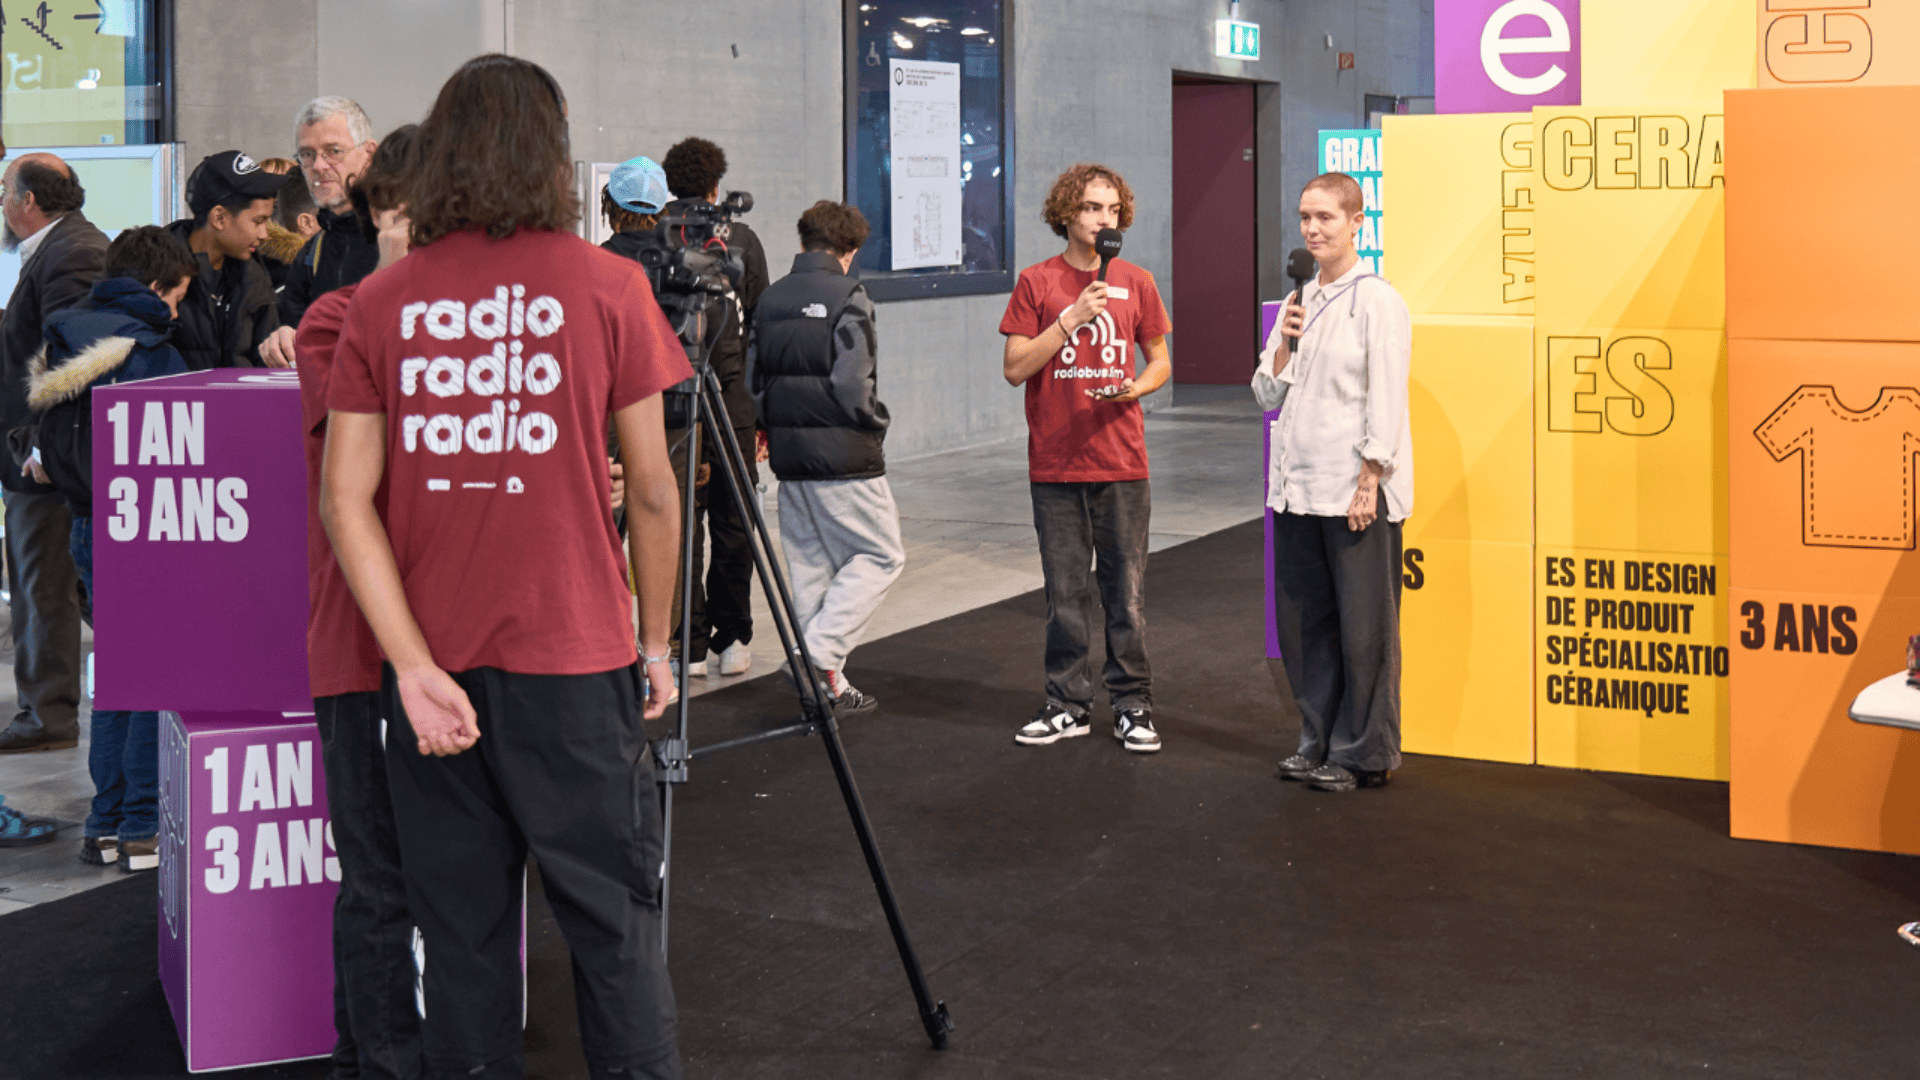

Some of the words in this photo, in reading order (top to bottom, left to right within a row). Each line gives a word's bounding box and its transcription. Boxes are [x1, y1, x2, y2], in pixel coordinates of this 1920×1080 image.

[1764, 0, 1873, 84] C
[401, 284, 564, 341] radio
[401, 339, 562, 398] radio
[1054, 365, 1125, 379] radiobus.fm
[1547, 336, 1675, 436] ES
[107, 401, 129, 466] 1
[138, 401, 205, 466] AN
[402, 398, 558, 455] radio
[107, 476, 140, 542] 3
[148, 476, 249, 542] ANS
[1546, 556, 1576, 587] ES
[1584, 558, 1615, 590] EN
[1624, 560, 1716, 596] DESIGN
[1546, 595, 1576, 627] DE
[1585, 598, 1694, 634] PRODUIT
[1740, 600, 1766, 650] 3
[1773, 602, 1858, 656] ANS
[1546, 670, 1689, 718] CÉRAMIQUE
[204, 747, 228, 815] 1
[239, 740, 313, 812] AN
[204, 825, 240, 894] 3
